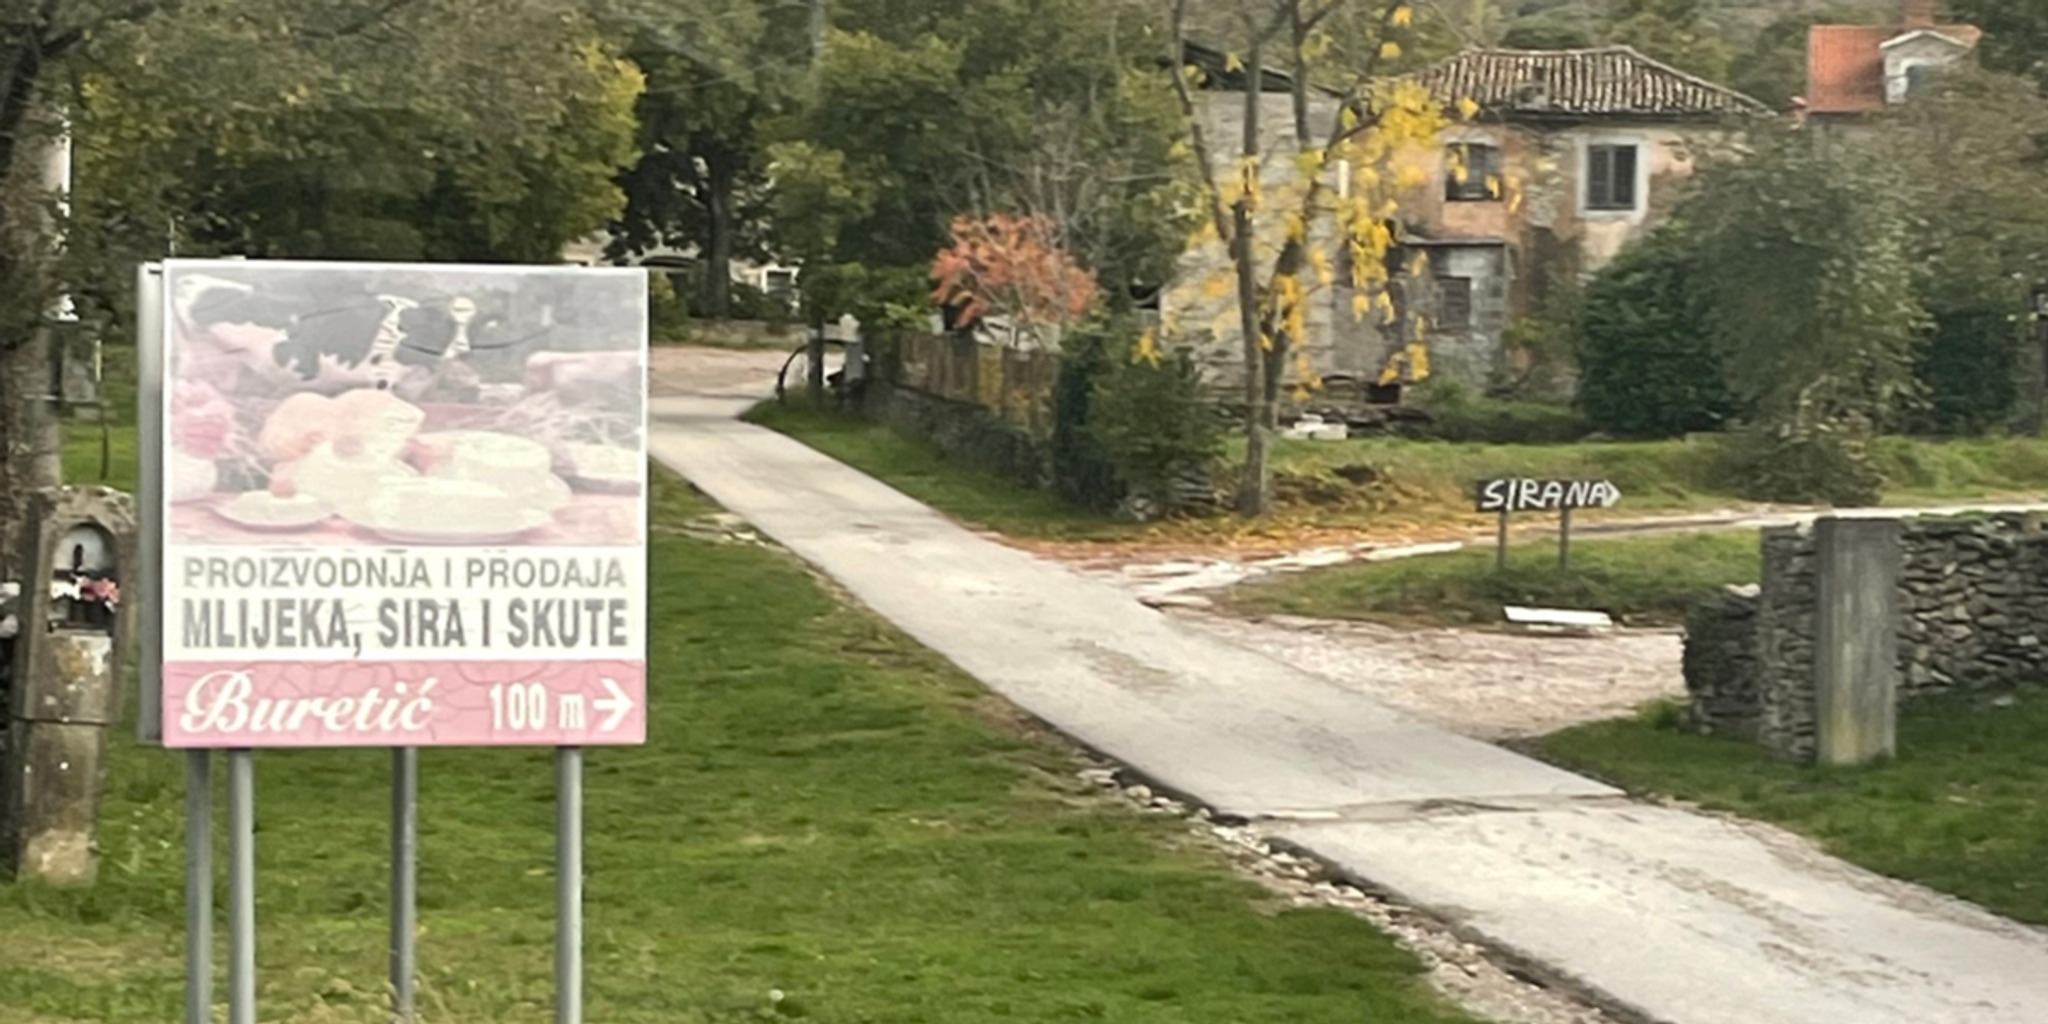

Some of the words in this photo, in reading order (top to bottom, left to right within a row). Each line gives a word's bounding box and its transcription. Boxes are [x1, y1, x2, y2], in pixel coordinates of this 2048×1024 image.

[1481, 479, 1608, 511] SIRANA
[183, 556, 432, 588] PROIZVODNJA
[444, 557, 452, 587] I
[466, 556, 627, 588] PRODAJA
[182, 598, 363, 657] MLIJEKA,
[378, 598, 467, 648] SIRA
[481, 599, 491, 647] I
[507, 597, 629, 647] SKUTE
[180, 669, 440, 734] Buretić
[489, 682, 547, 731] 100
[558, 692, 586, 730] m
